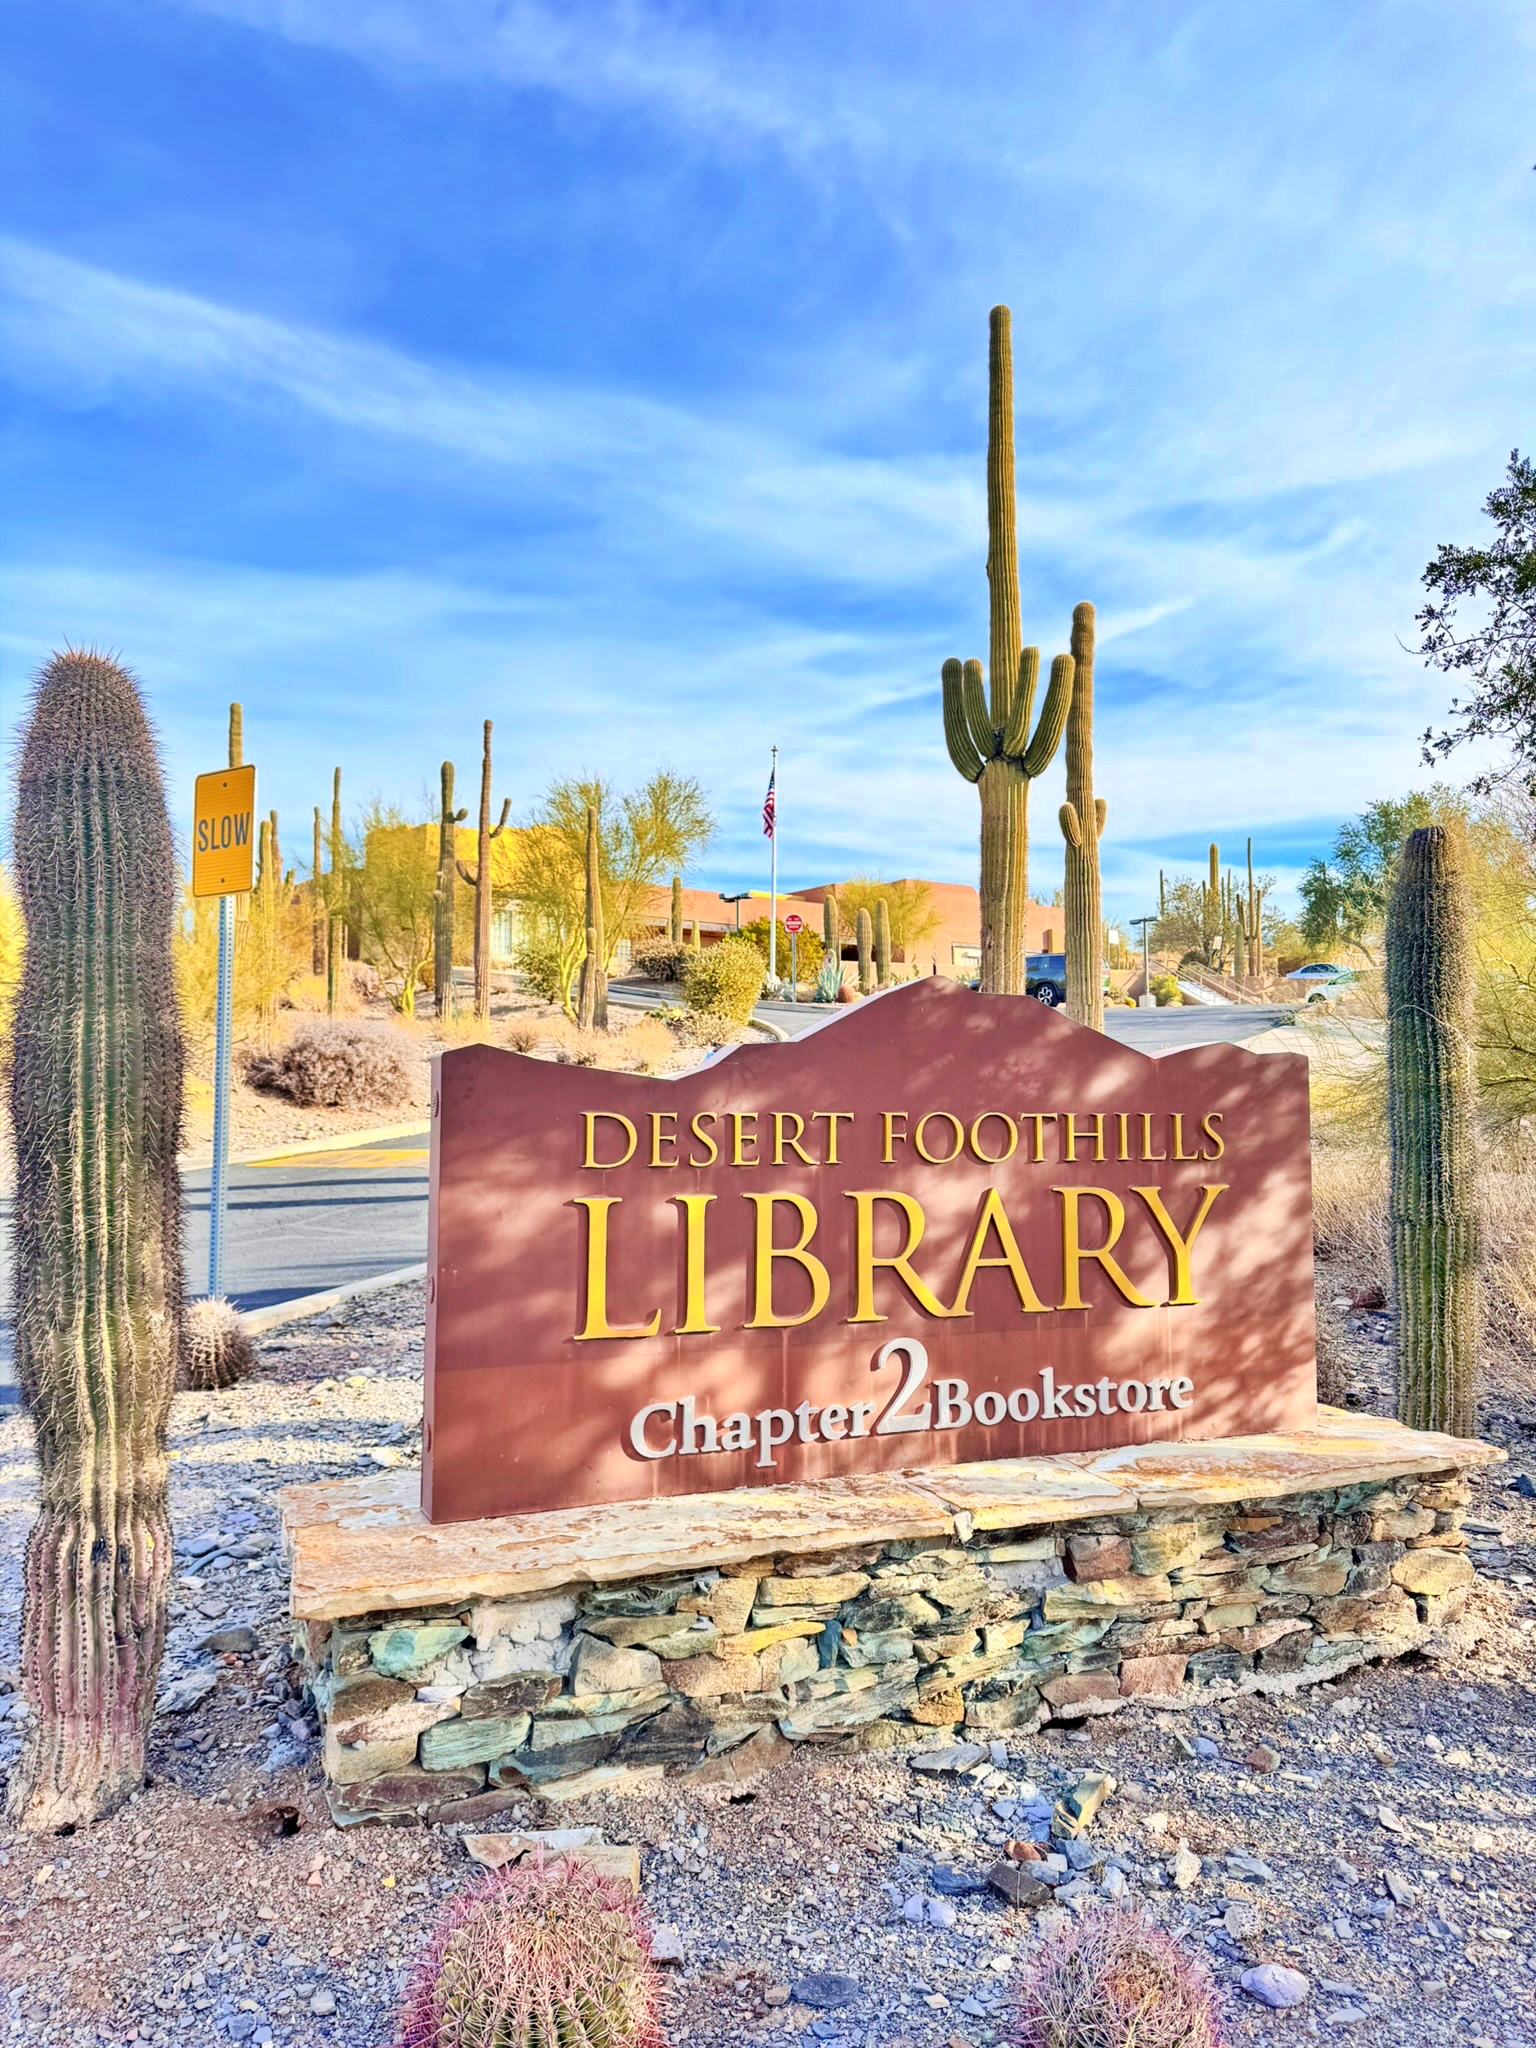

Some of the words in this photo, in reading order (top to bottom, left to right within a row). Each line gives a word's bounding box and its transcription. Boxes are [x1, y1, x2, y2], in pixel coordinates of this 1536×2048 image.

[198, 812, 250, 851] SLOW
[580, 1111, 855, 1169] DESERT
[879, 1111, 1226, 1165] FOOTHILLS
[572, 1184, 1230, 1341] LIBRARY
[629, 1395, 877, 1468] Chapter
[875, 1336, 932, 1435] 2
[932, 1366, 1195, 1430] Bookstore
